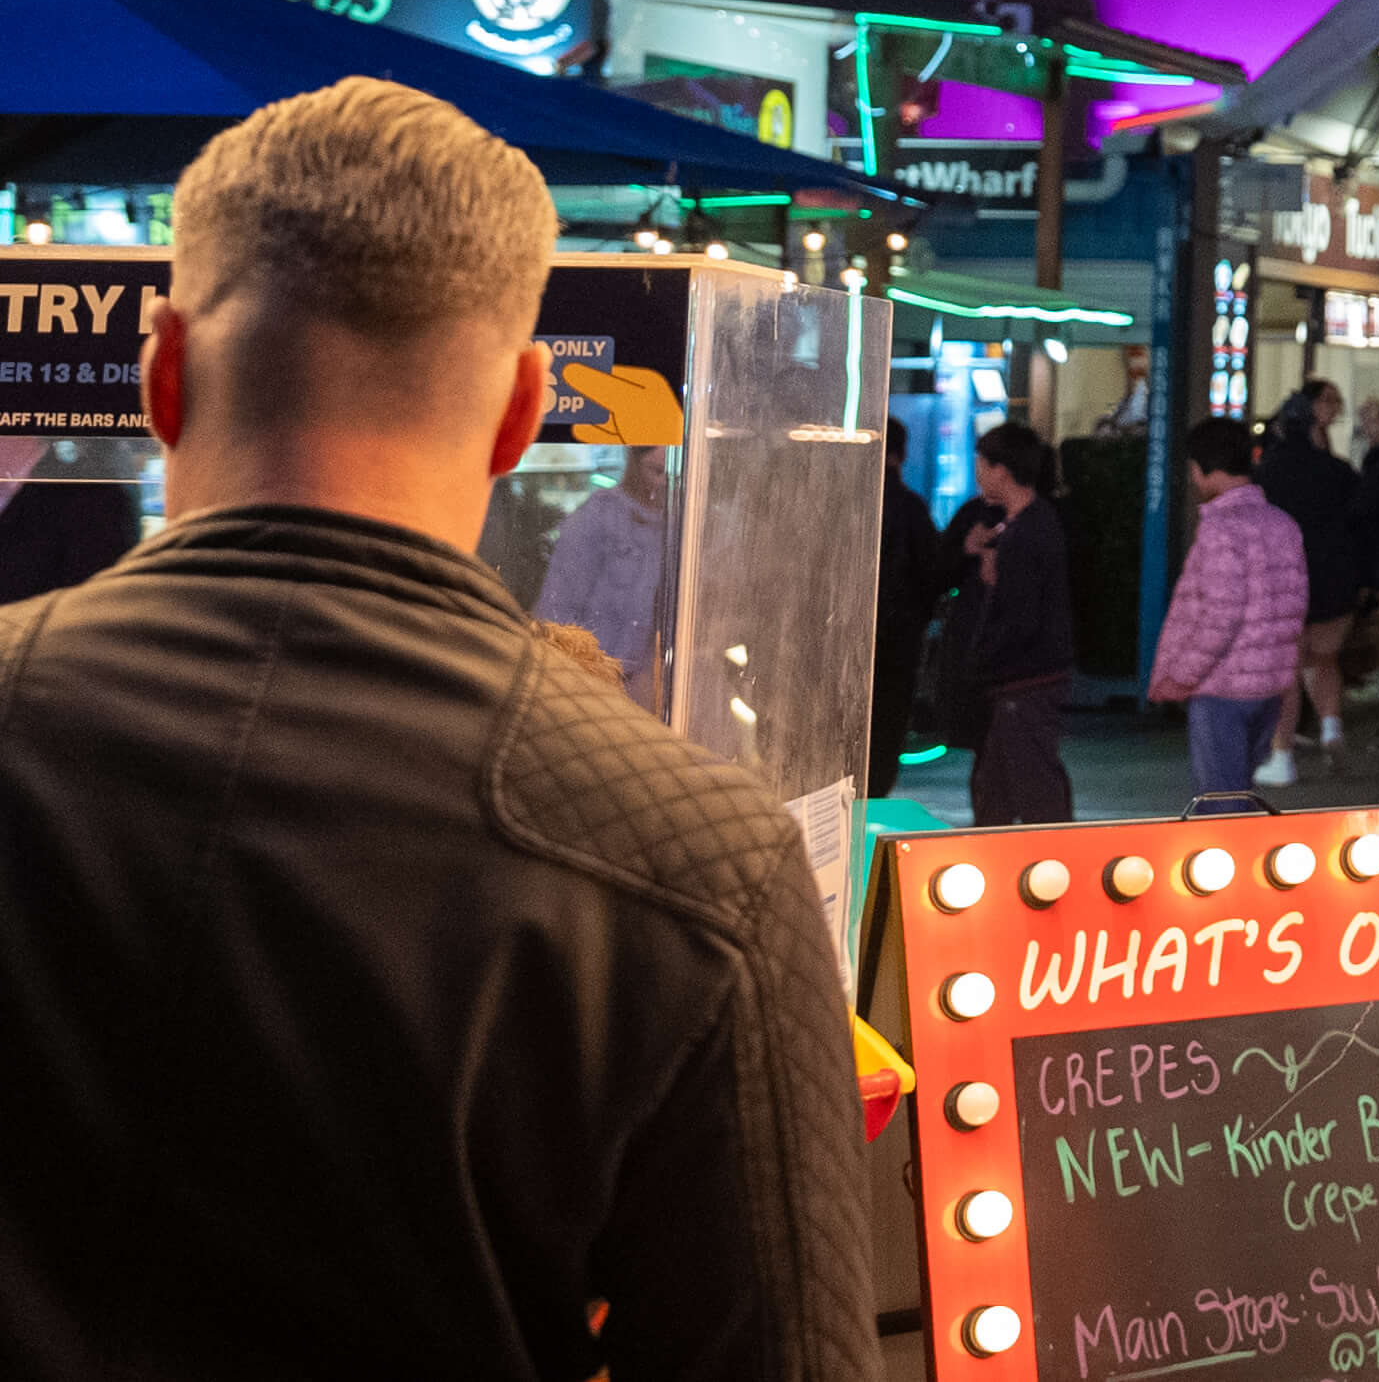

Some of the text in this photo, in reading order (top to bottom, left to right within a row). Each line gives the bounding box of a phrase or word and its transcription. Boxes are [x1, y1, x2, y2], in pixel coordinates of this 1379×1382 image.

[0, 283, 125, 335] TRY
[40, 364, 70, 384] 13
[76, 364, 96, 384] &
[552, 339, 607, 357] ONLY
[0, 412, 32, 428] AFF
[34, 413, 67, 427] THE
[70, 414, 114, 428] BARS
[1019, 911, 1304, 1010] WHAT'S
[1039, 1040, 1221, 1115] CREPES
[1283, 1178, 1379, 1243] Crepe
[1074, 1303, 1189, 1379] Main
